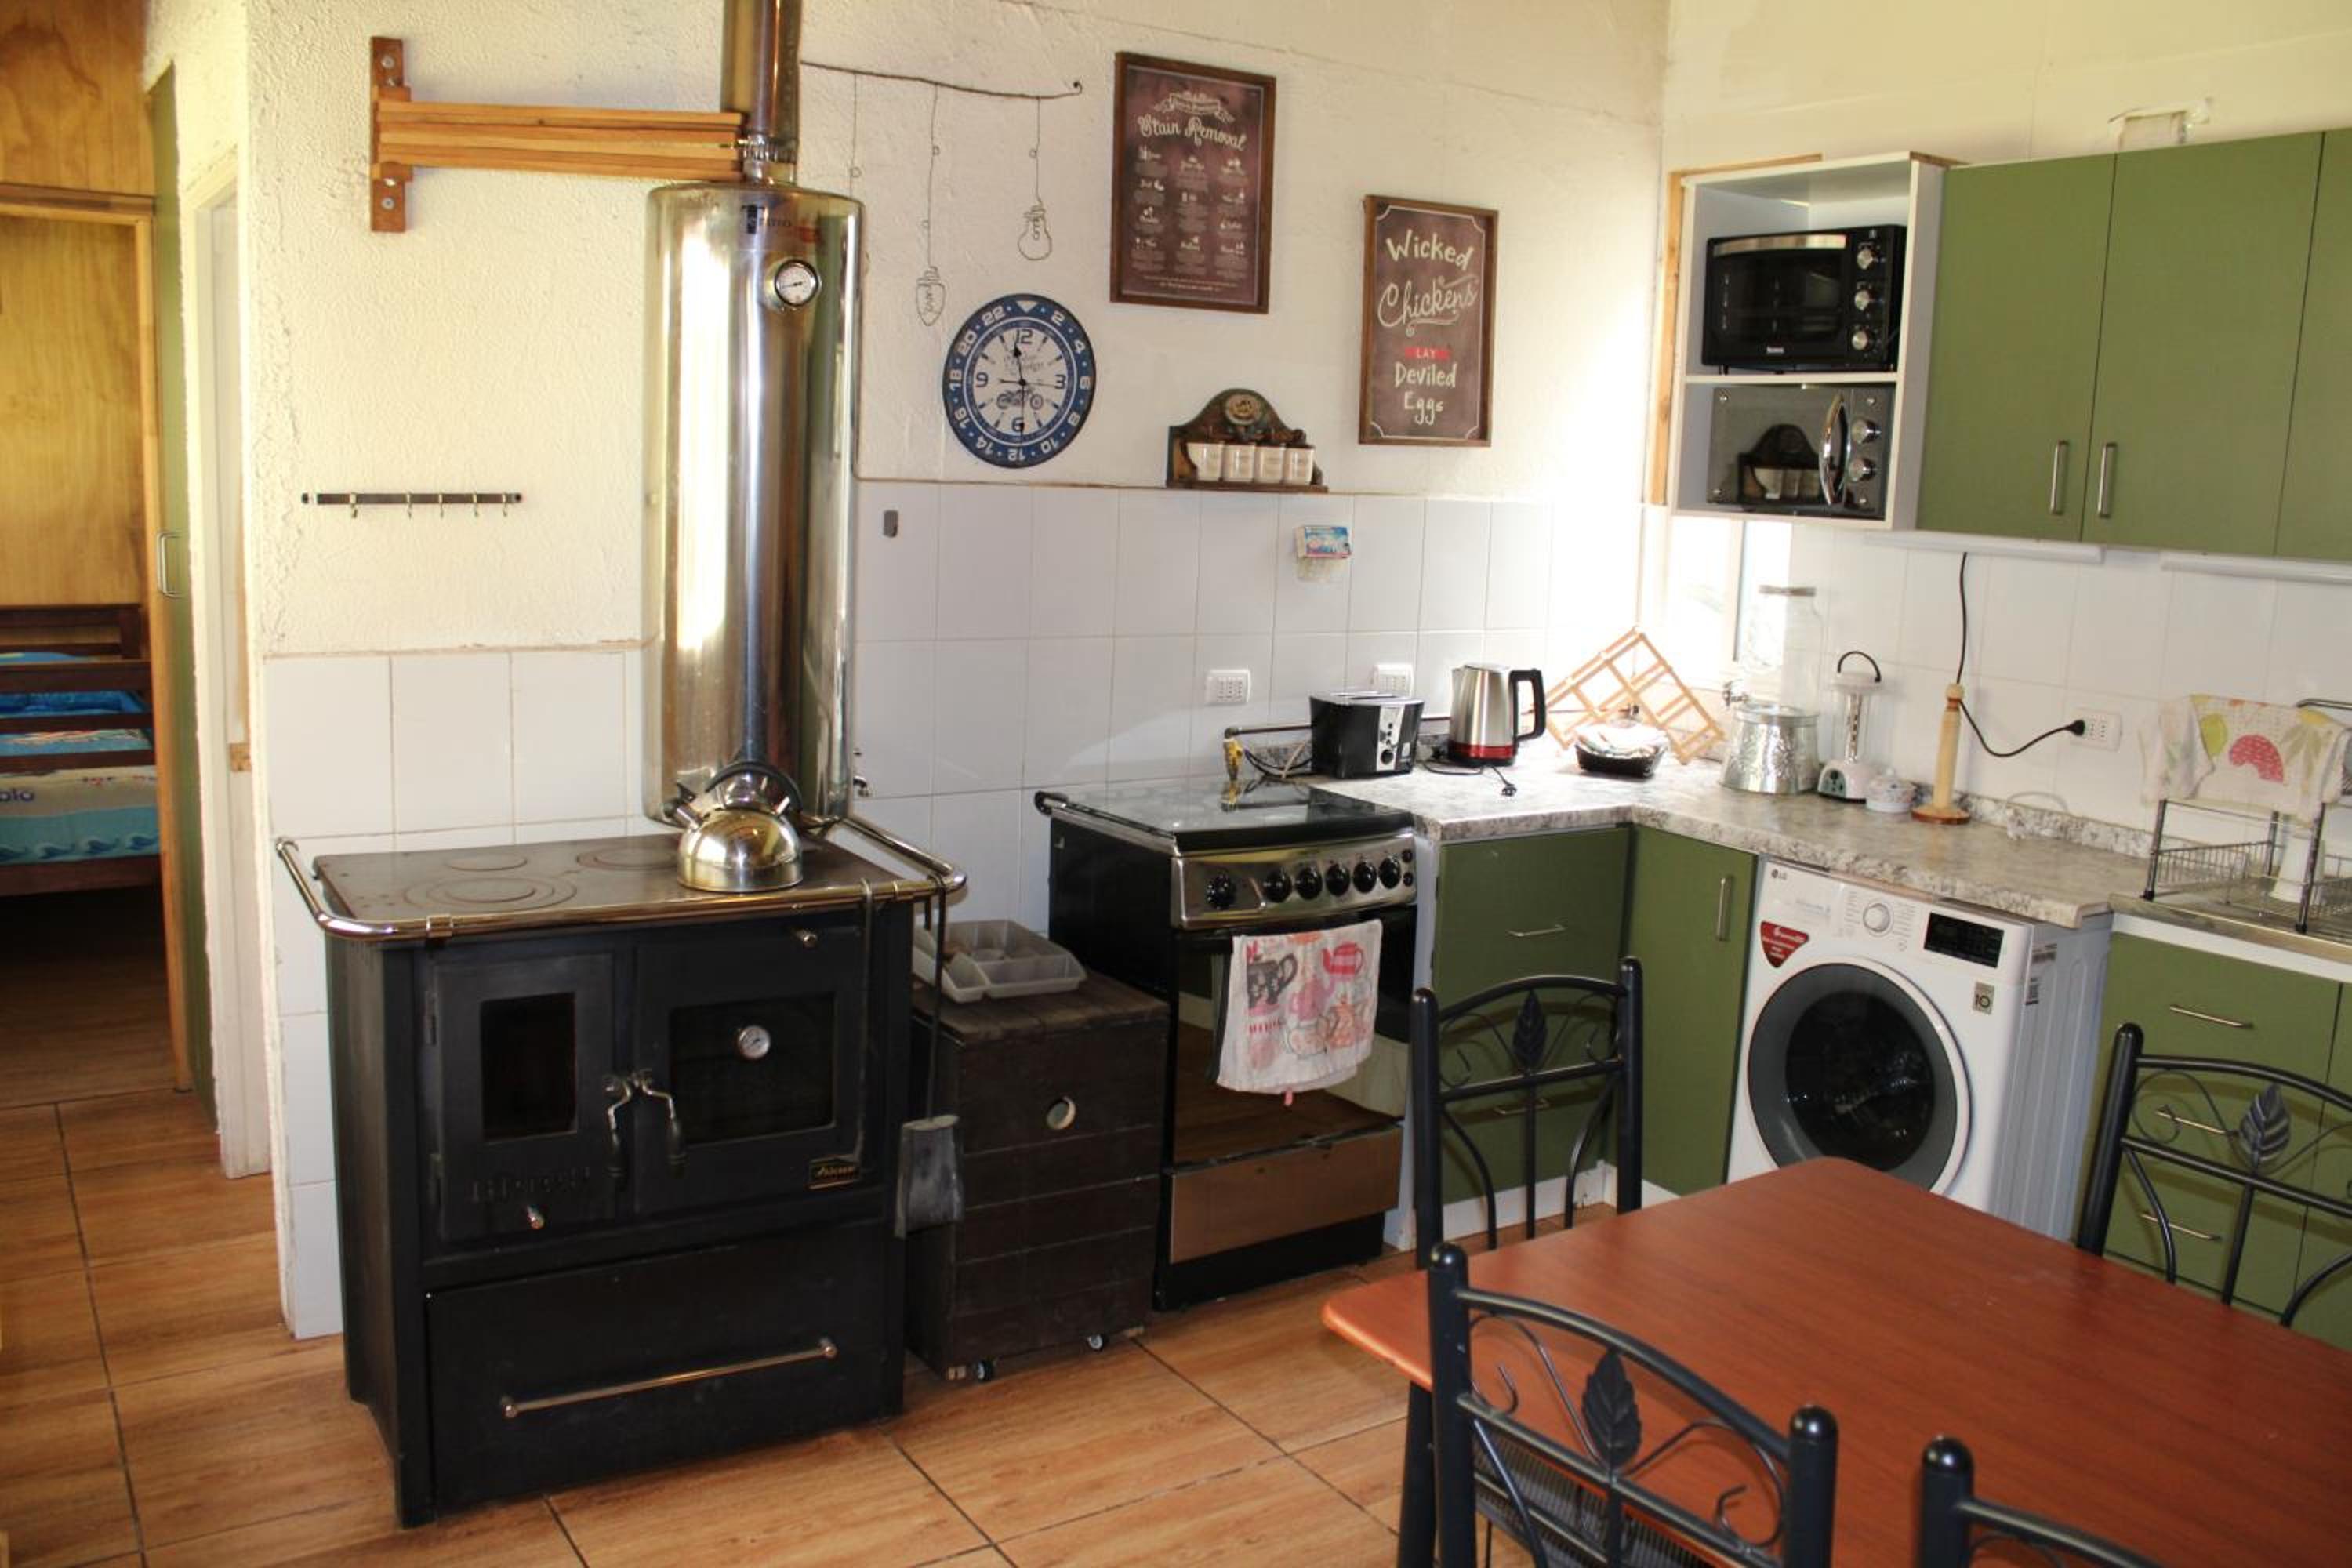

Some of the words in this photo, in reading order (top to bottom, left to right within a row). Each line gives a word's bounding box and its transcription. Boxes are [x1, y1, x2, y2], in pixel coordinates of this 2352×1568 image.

[1185, 116, 1247, 151] Removal
[1385, 228, 1475, 272] Wicked
[1377, 274, 1479, 328] Chickens
[981, 305, 1006, 325] 22
[1051, 310, 1065, 325] 2
[957, 333, 978, 357] 20
[1016, 329, 1033, 344] 12
[1073, 339, 1087, 354] 4
[1416, 349, 1438, 359] LAY
[975, 372, 989, 388] 9
[1055, 374, 1067, 390] 3
[1394, 361, 1458, 389] Deviled
[1404, 391, 1444, 426] Eggs
[1011, 416, 1025, 433] 6
[976, 436, 995, 455] 14
[1040, 438, 1060, 455] 10
[1007, 448, 1027, 461] 12
